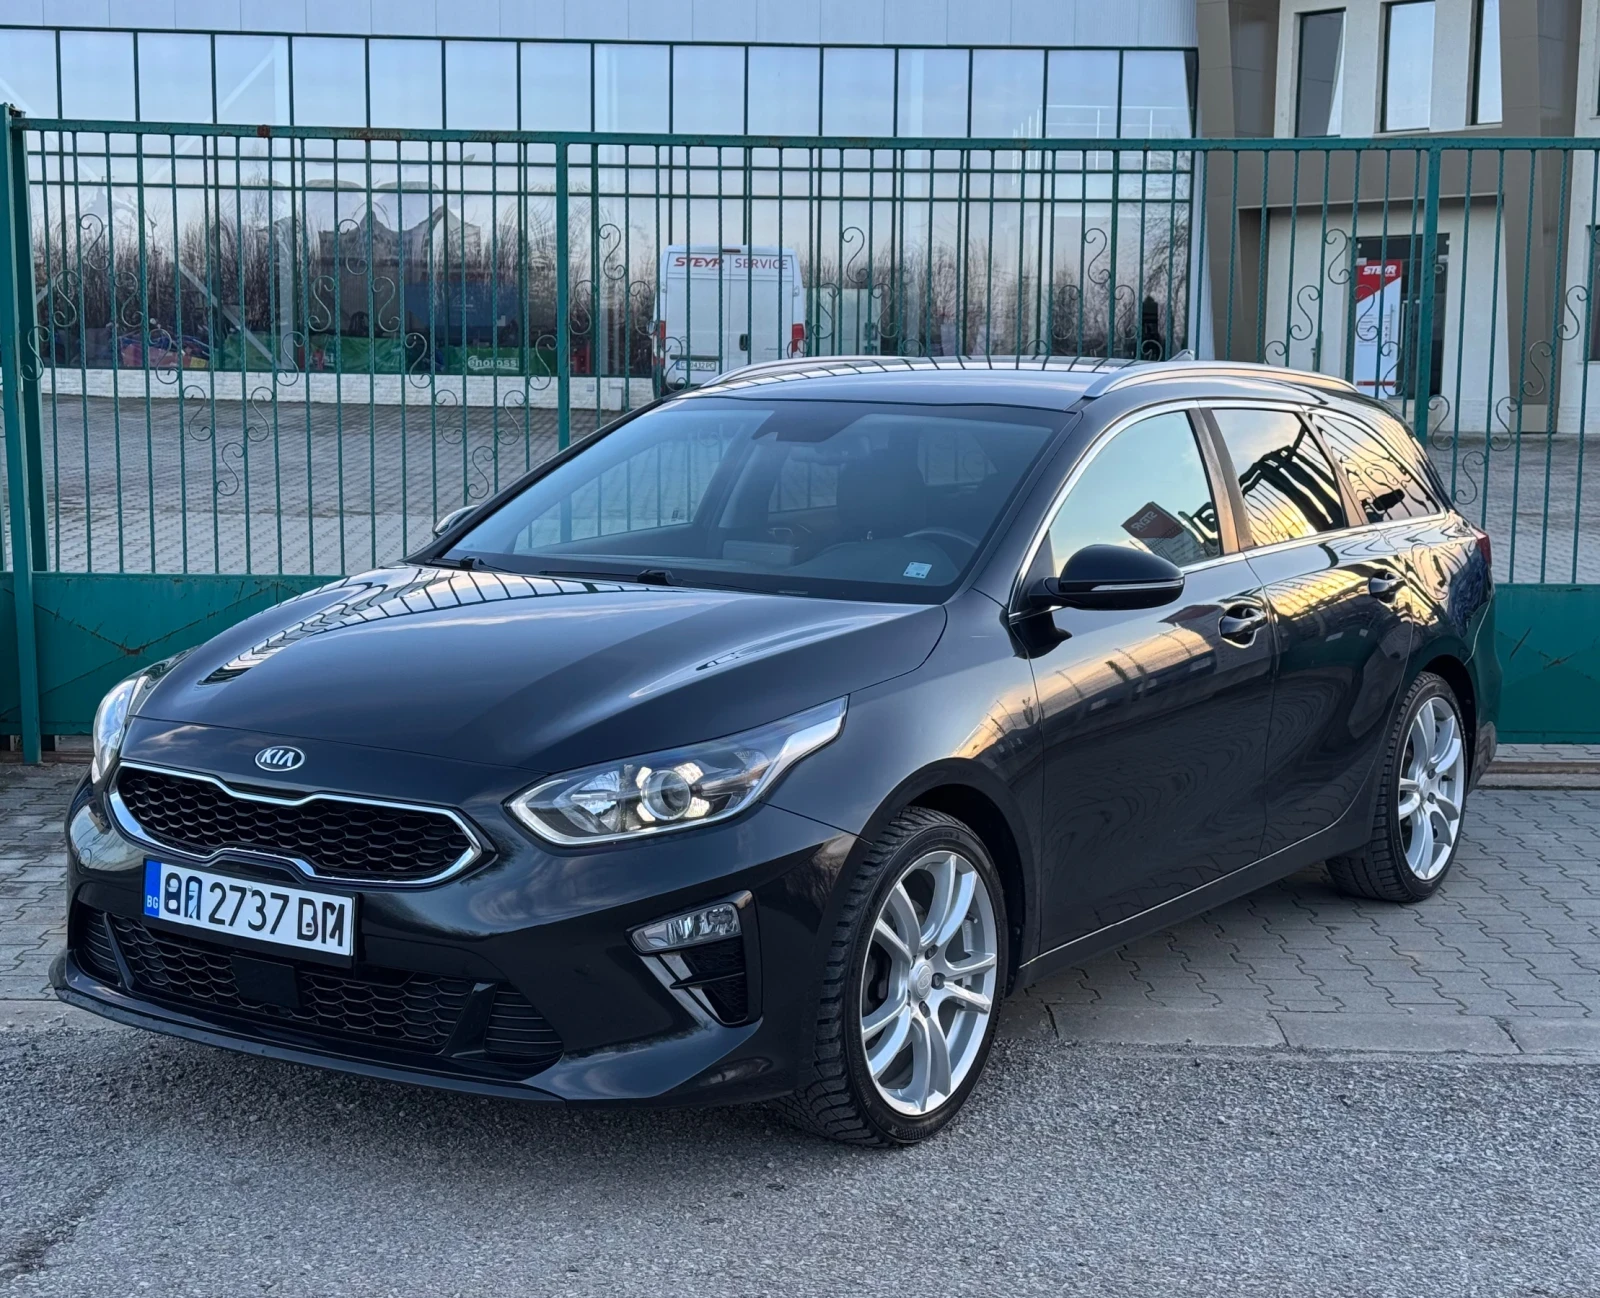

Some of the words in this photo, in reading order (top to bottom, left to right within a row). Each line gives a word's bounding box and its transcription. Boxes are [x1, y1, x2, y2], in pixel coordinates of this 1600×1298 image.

[735, 258, 788, 270] SERVICE
[260, 748, 295, 767] KIA
[147, 895, 159, 909] BG
[208, 881, 290, 935] 2737
